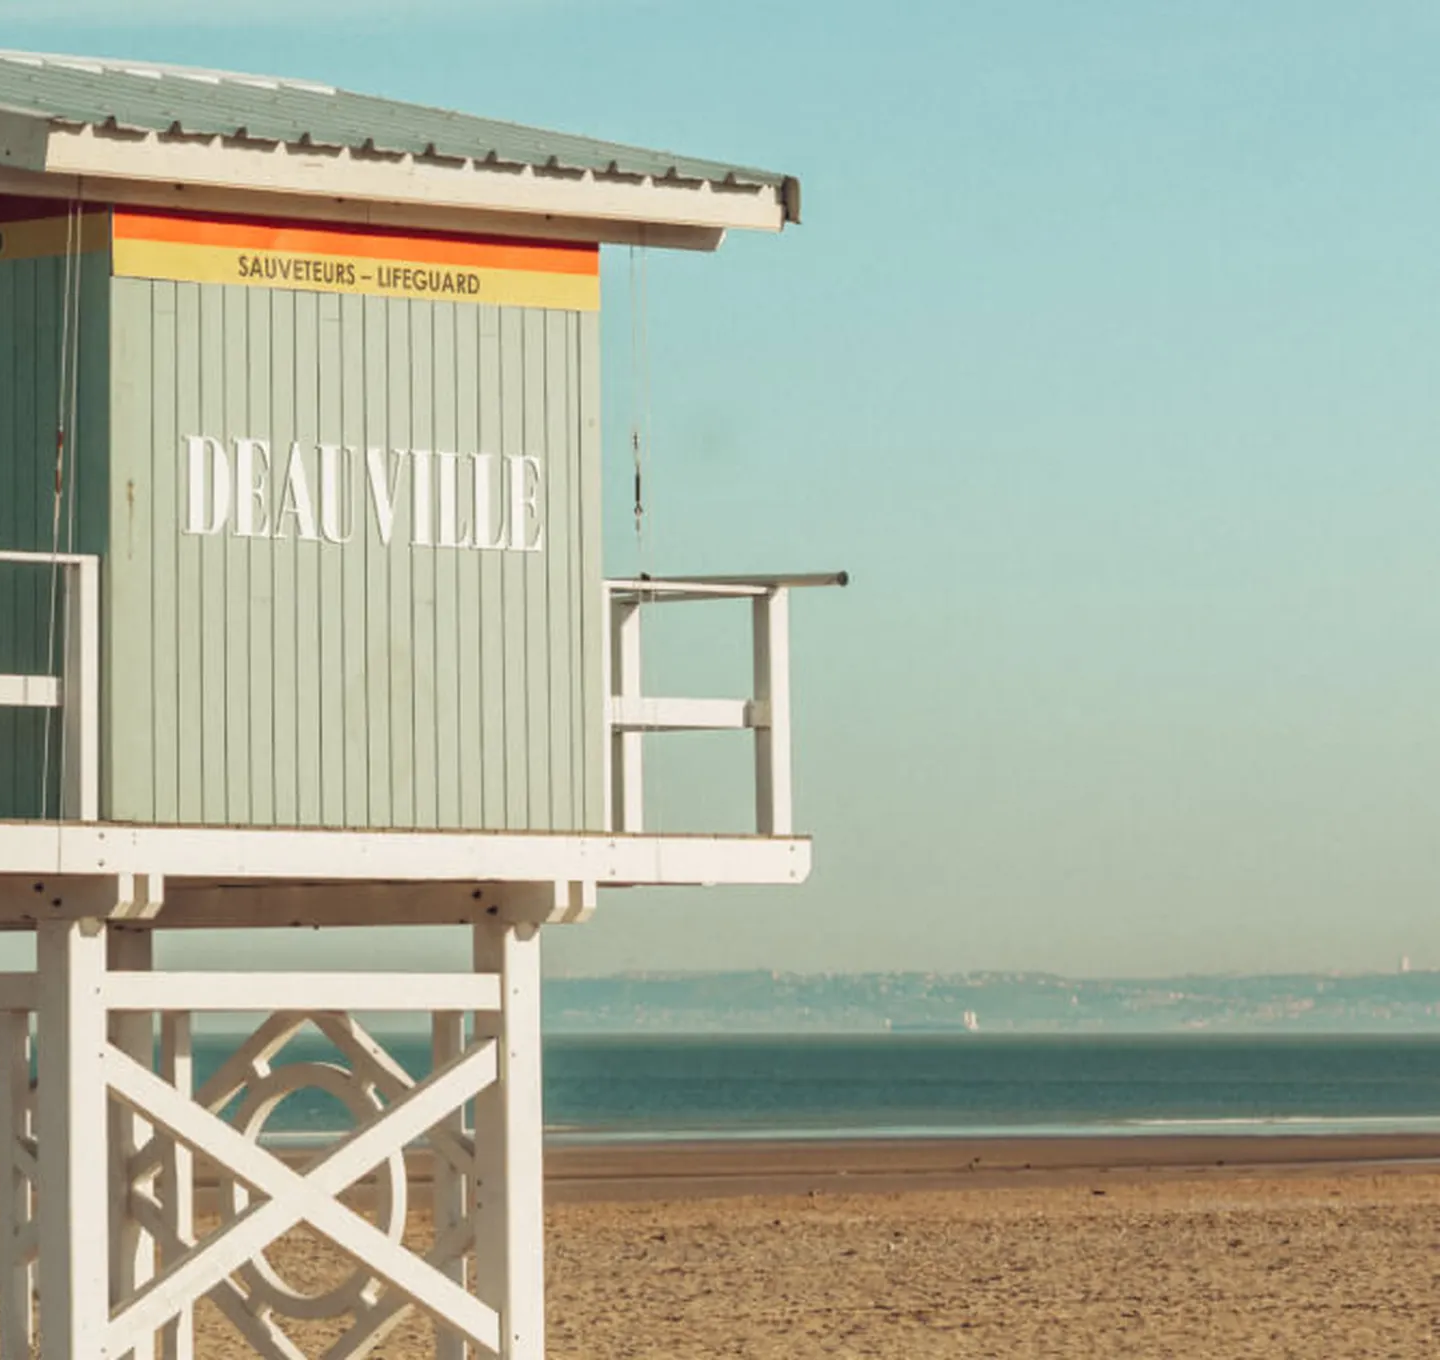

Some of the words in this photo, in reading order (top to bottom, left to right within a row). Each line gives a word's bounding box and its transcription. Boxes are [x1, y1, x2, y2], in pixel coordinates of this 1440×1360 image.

[238, 256, 356, 286] SAUVETEURS
[377, 267, 481, 295] LIFEGUARD
[181, 433, 543, 552] DEAUVILLE
